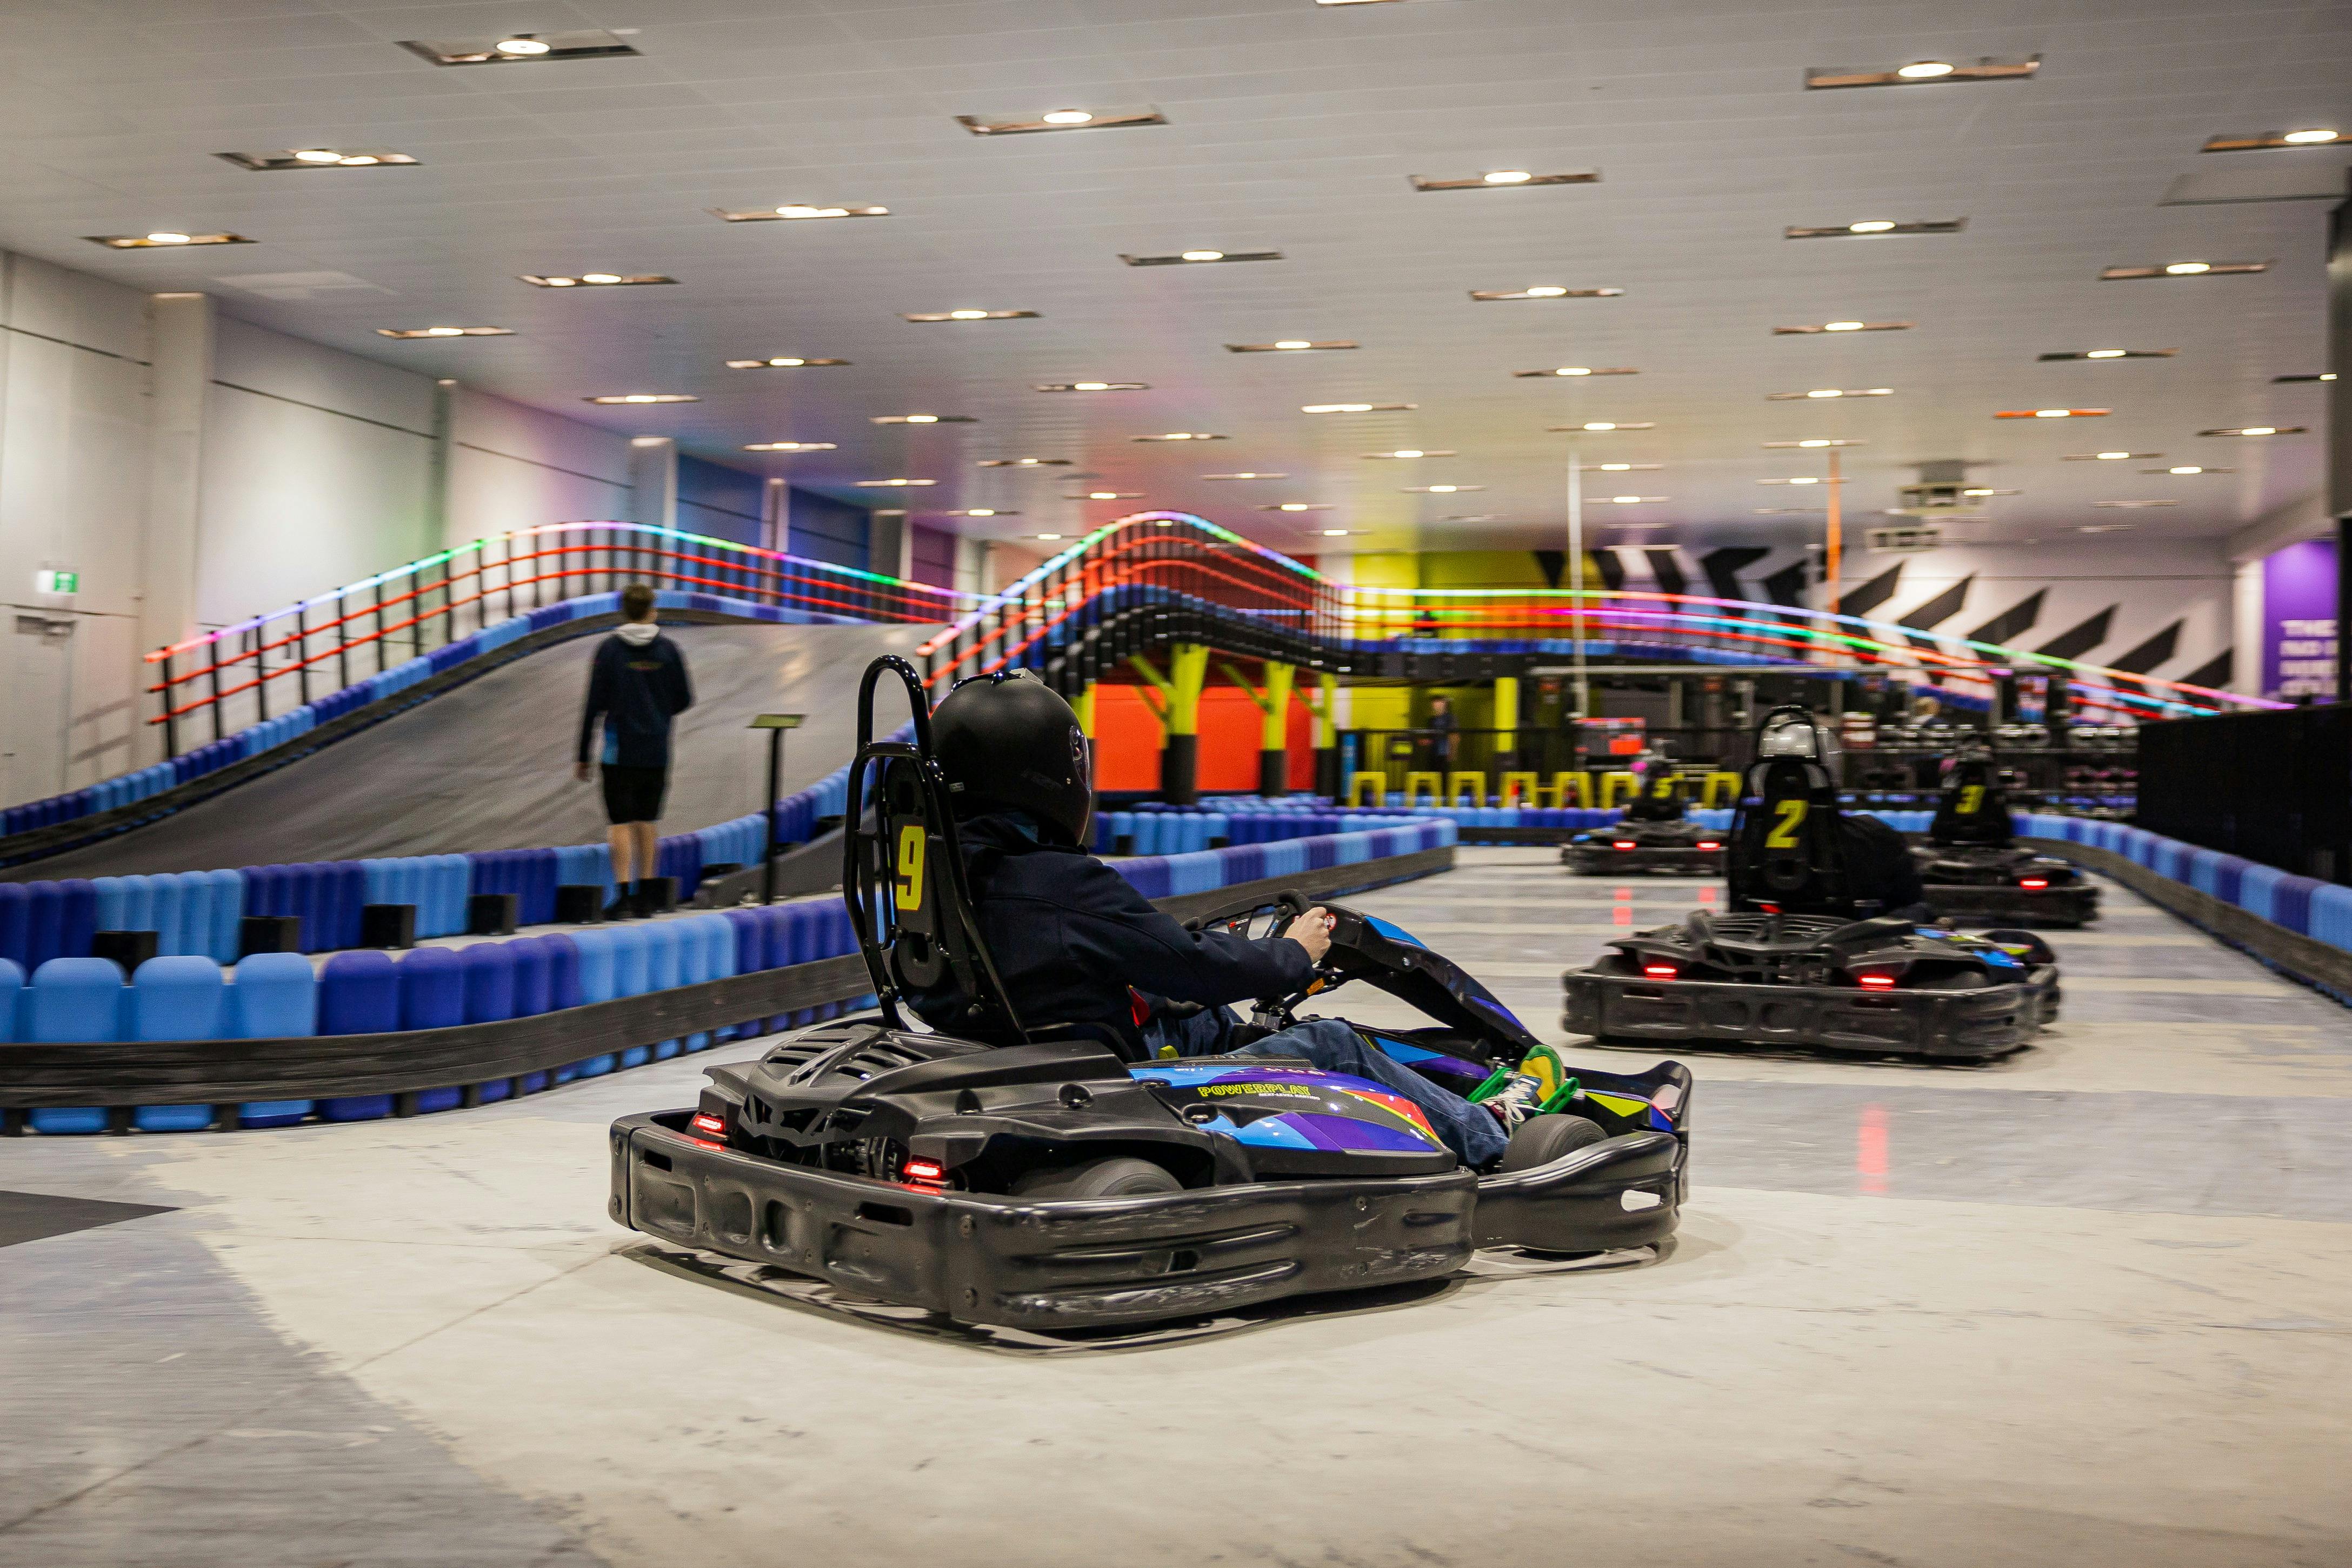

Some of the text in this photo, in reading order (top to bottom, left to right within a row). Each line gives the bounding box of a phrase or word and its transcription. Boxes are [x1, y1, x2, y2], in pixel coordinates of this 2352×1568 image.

[1955, 785, 1986, 813] 3
[1765, 800, 1808, 848] 2
[896, 825, 925, 910] 9
[1198, 1084, 1311, 1097] POWERPLAY
